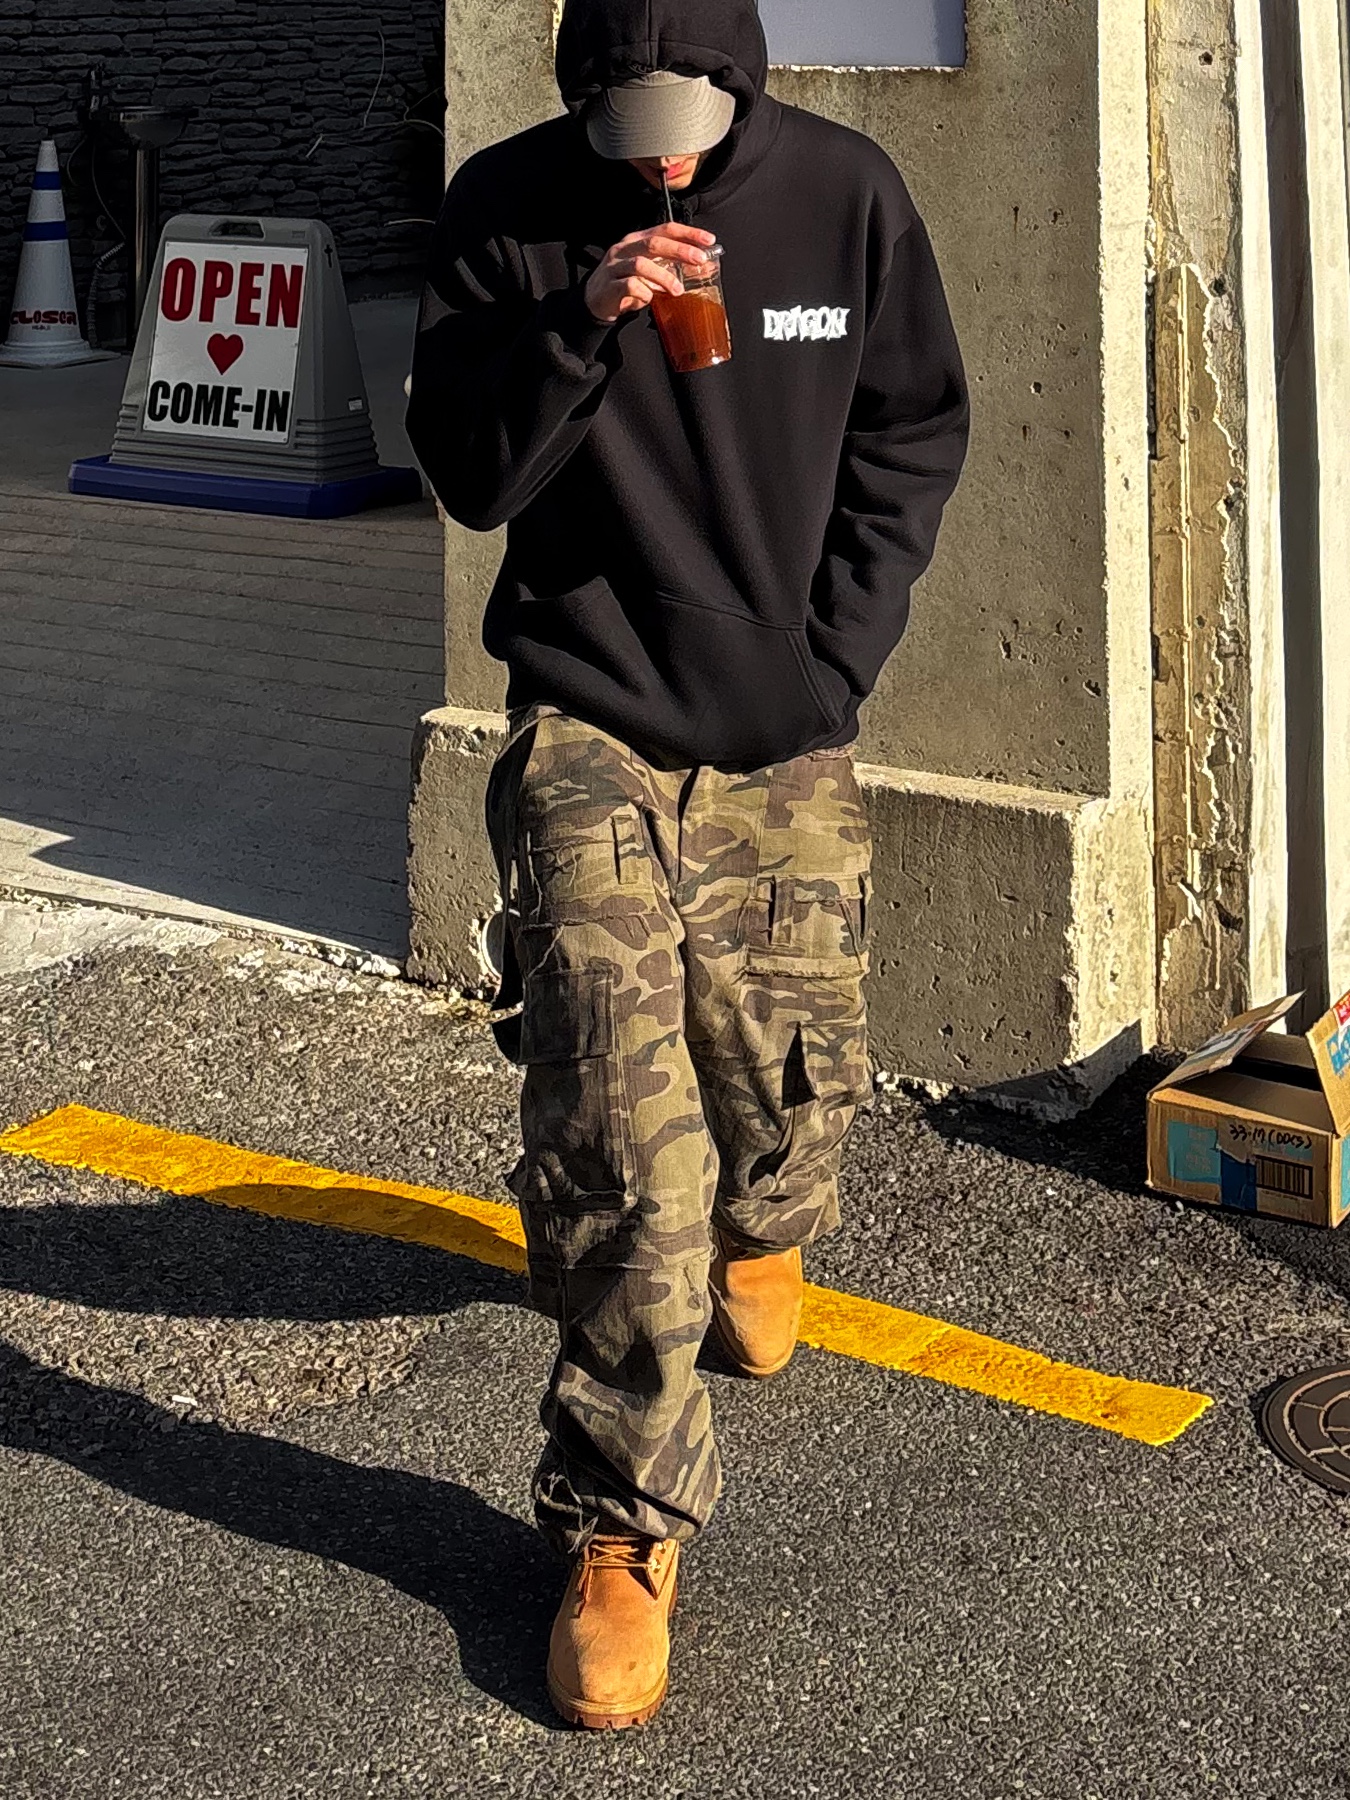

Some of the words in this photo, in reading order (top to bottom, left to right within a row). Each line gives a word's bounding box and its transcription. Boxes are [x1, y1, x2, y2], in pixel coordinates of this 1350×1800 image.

[161, 257, 304, 328] OPEN
[762, 305, 851, 342] DRAGON
[147, 380, 291, 432] COME-IN
